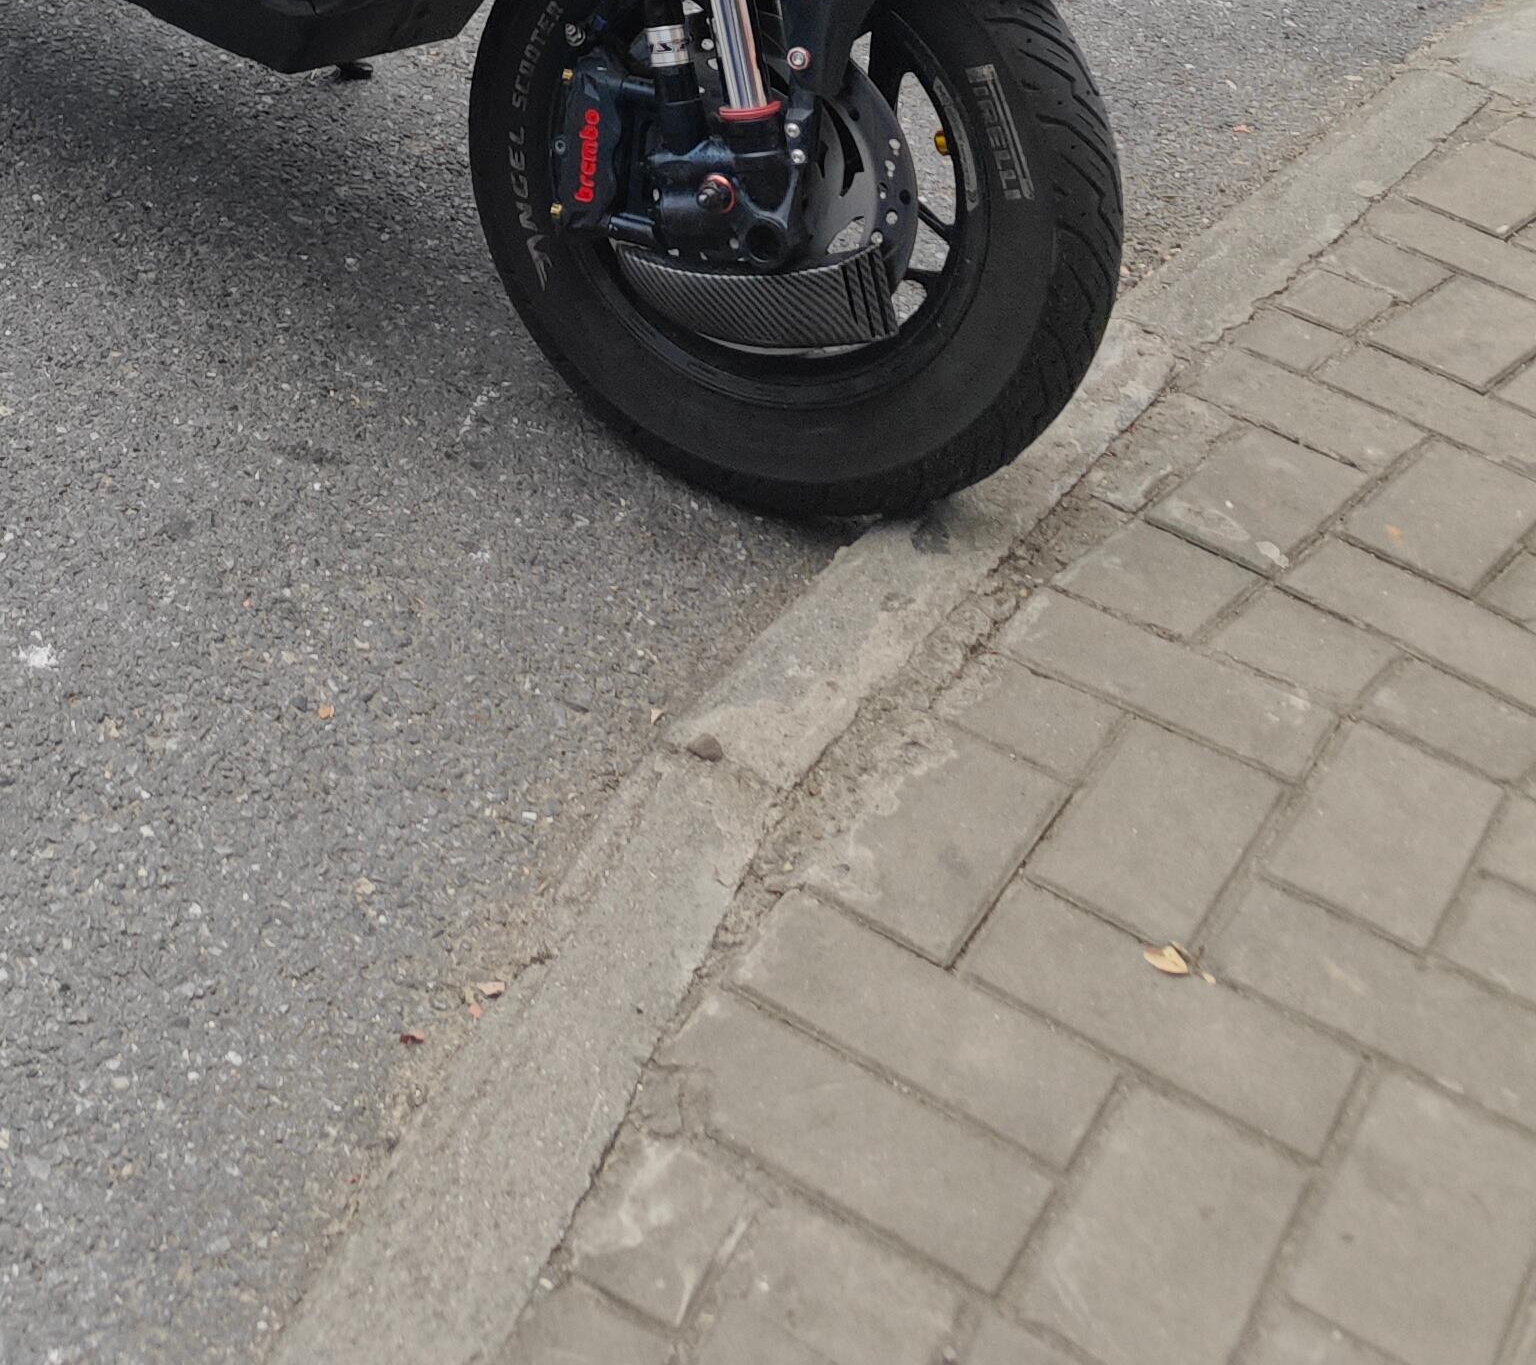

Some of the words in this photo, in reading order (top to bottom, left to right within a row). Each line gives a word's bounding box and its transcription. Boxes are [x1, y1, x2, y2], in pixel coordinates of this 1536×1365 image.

[512, 0, 564, 112] SCOOTER
[509, 126, 554, 292] ANGEL
[574, 108, 601, 203] brembo
